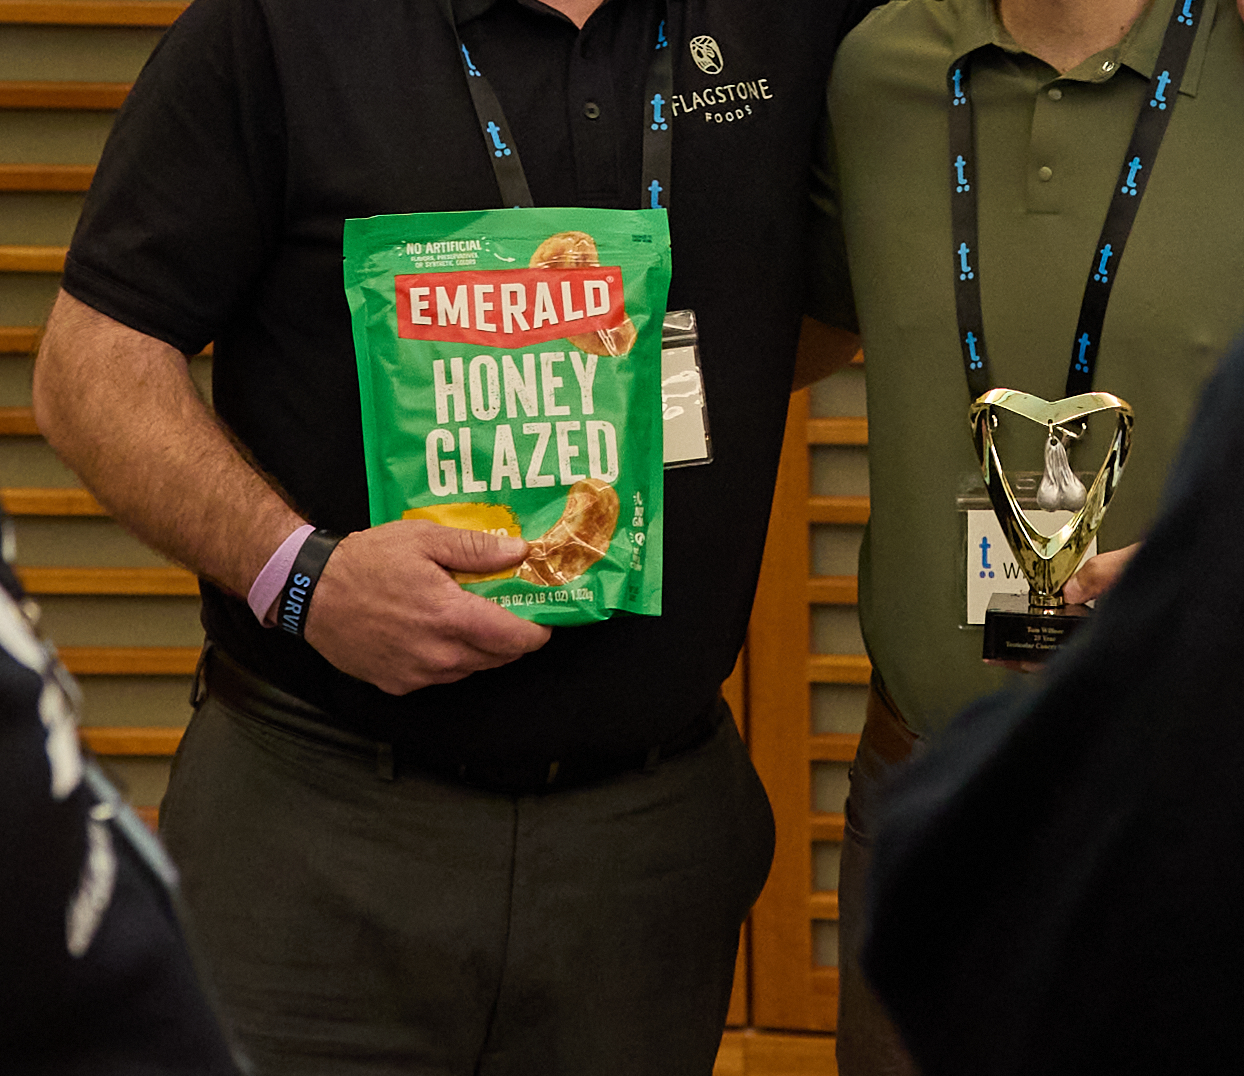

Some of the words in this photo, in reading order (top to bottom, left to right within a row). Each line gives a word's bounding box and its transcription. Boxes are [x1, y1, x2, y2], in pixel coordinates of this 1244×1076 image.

[671, 78, 773, 117] FLAGSTONE
[705, 104, 752, 124] FOODS
[406, 243, 422, 255] NO
[425, 240, 482, 254] ARTIFICIAL
[409, 279, 611, 334] EMERALD
[432, 351, 599, 425] HONEY
[425, 421, 620, 497] GLAZED
[500, 595, 511, 607] 36
[512, 594, 524, 606] OZ
[525, 594, 534, 606] (2
[535, 593, 546, 604] LB
[547, 592, 553, 602] 4
[555, 590, 569, 603] OZ)
